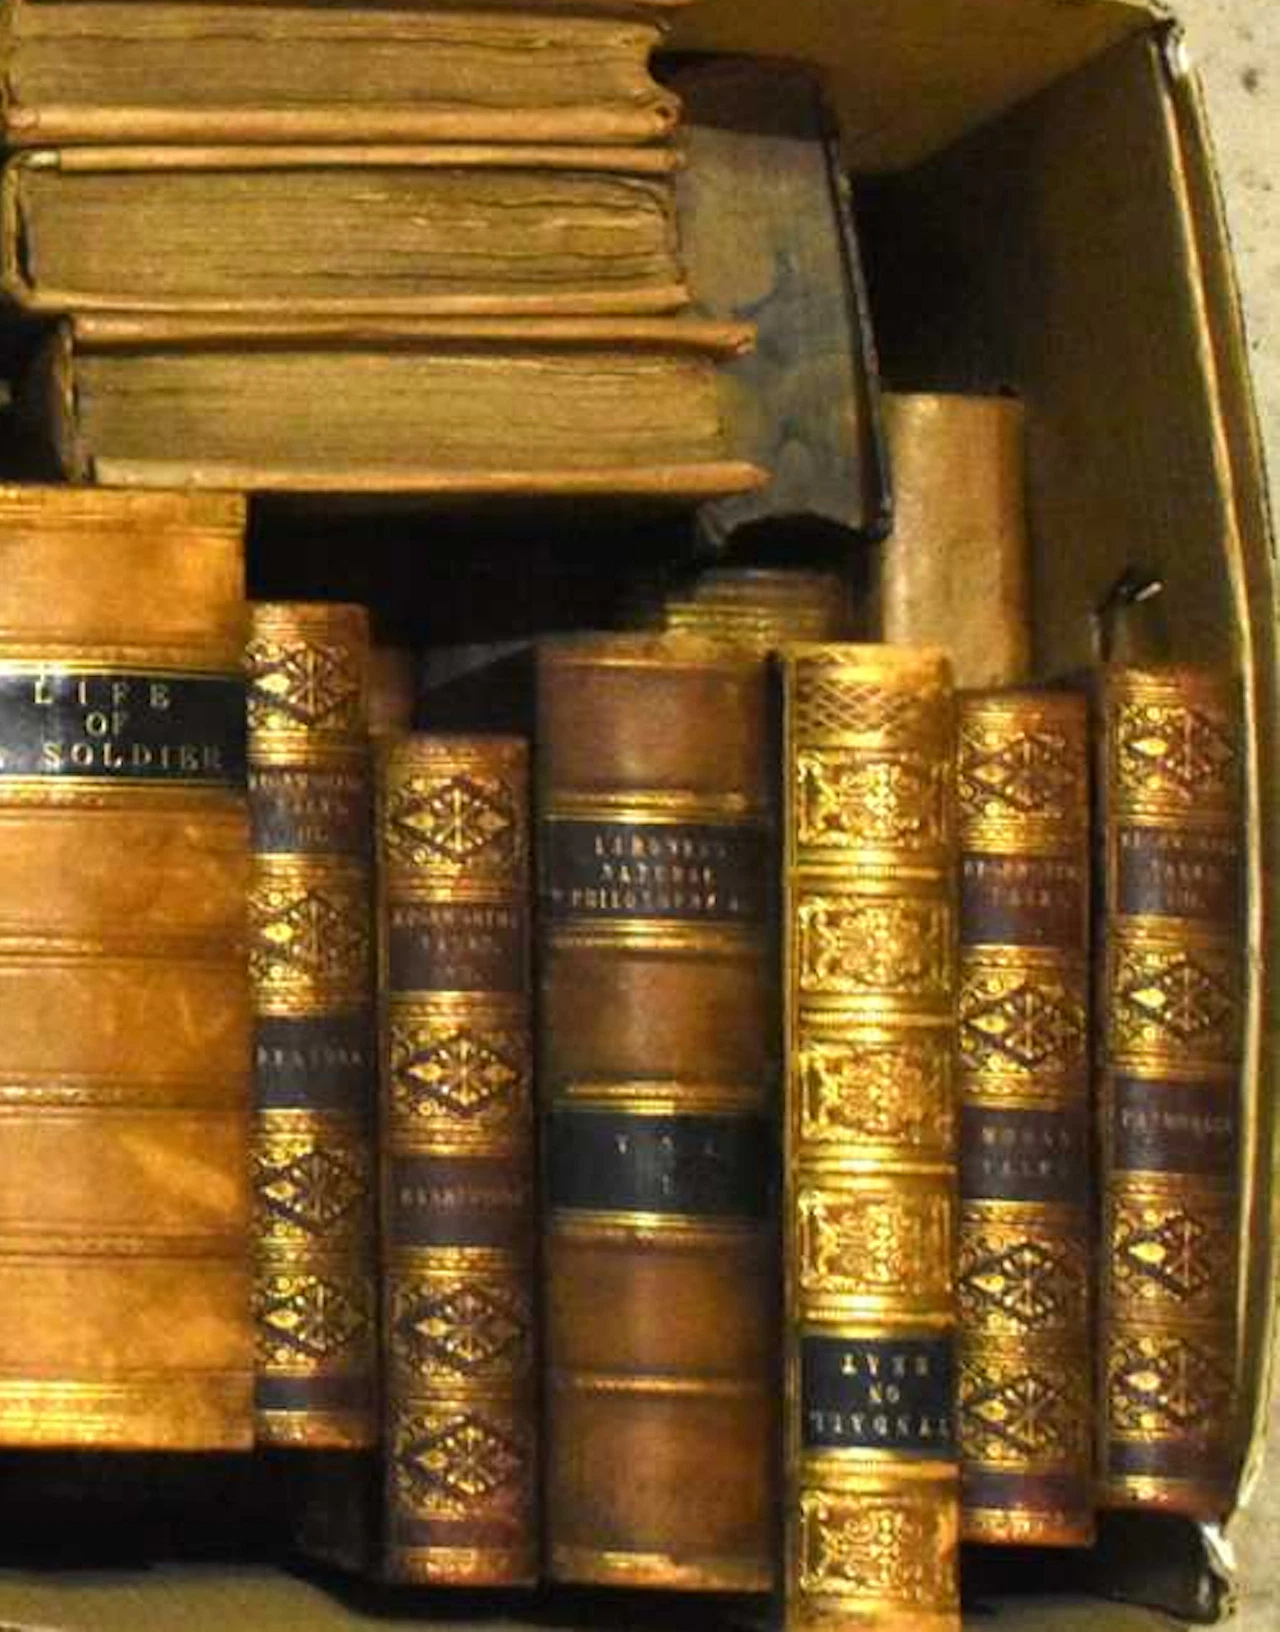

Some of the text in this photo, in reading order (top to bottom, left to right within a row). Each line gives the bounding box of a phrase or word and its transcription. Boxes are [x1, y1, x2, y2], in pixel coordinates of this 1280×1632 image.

[32, 679, 171, 710] LIFE
[85, 710, 128, 737] OF
[41, 741, 225, 772] SOLDIER
